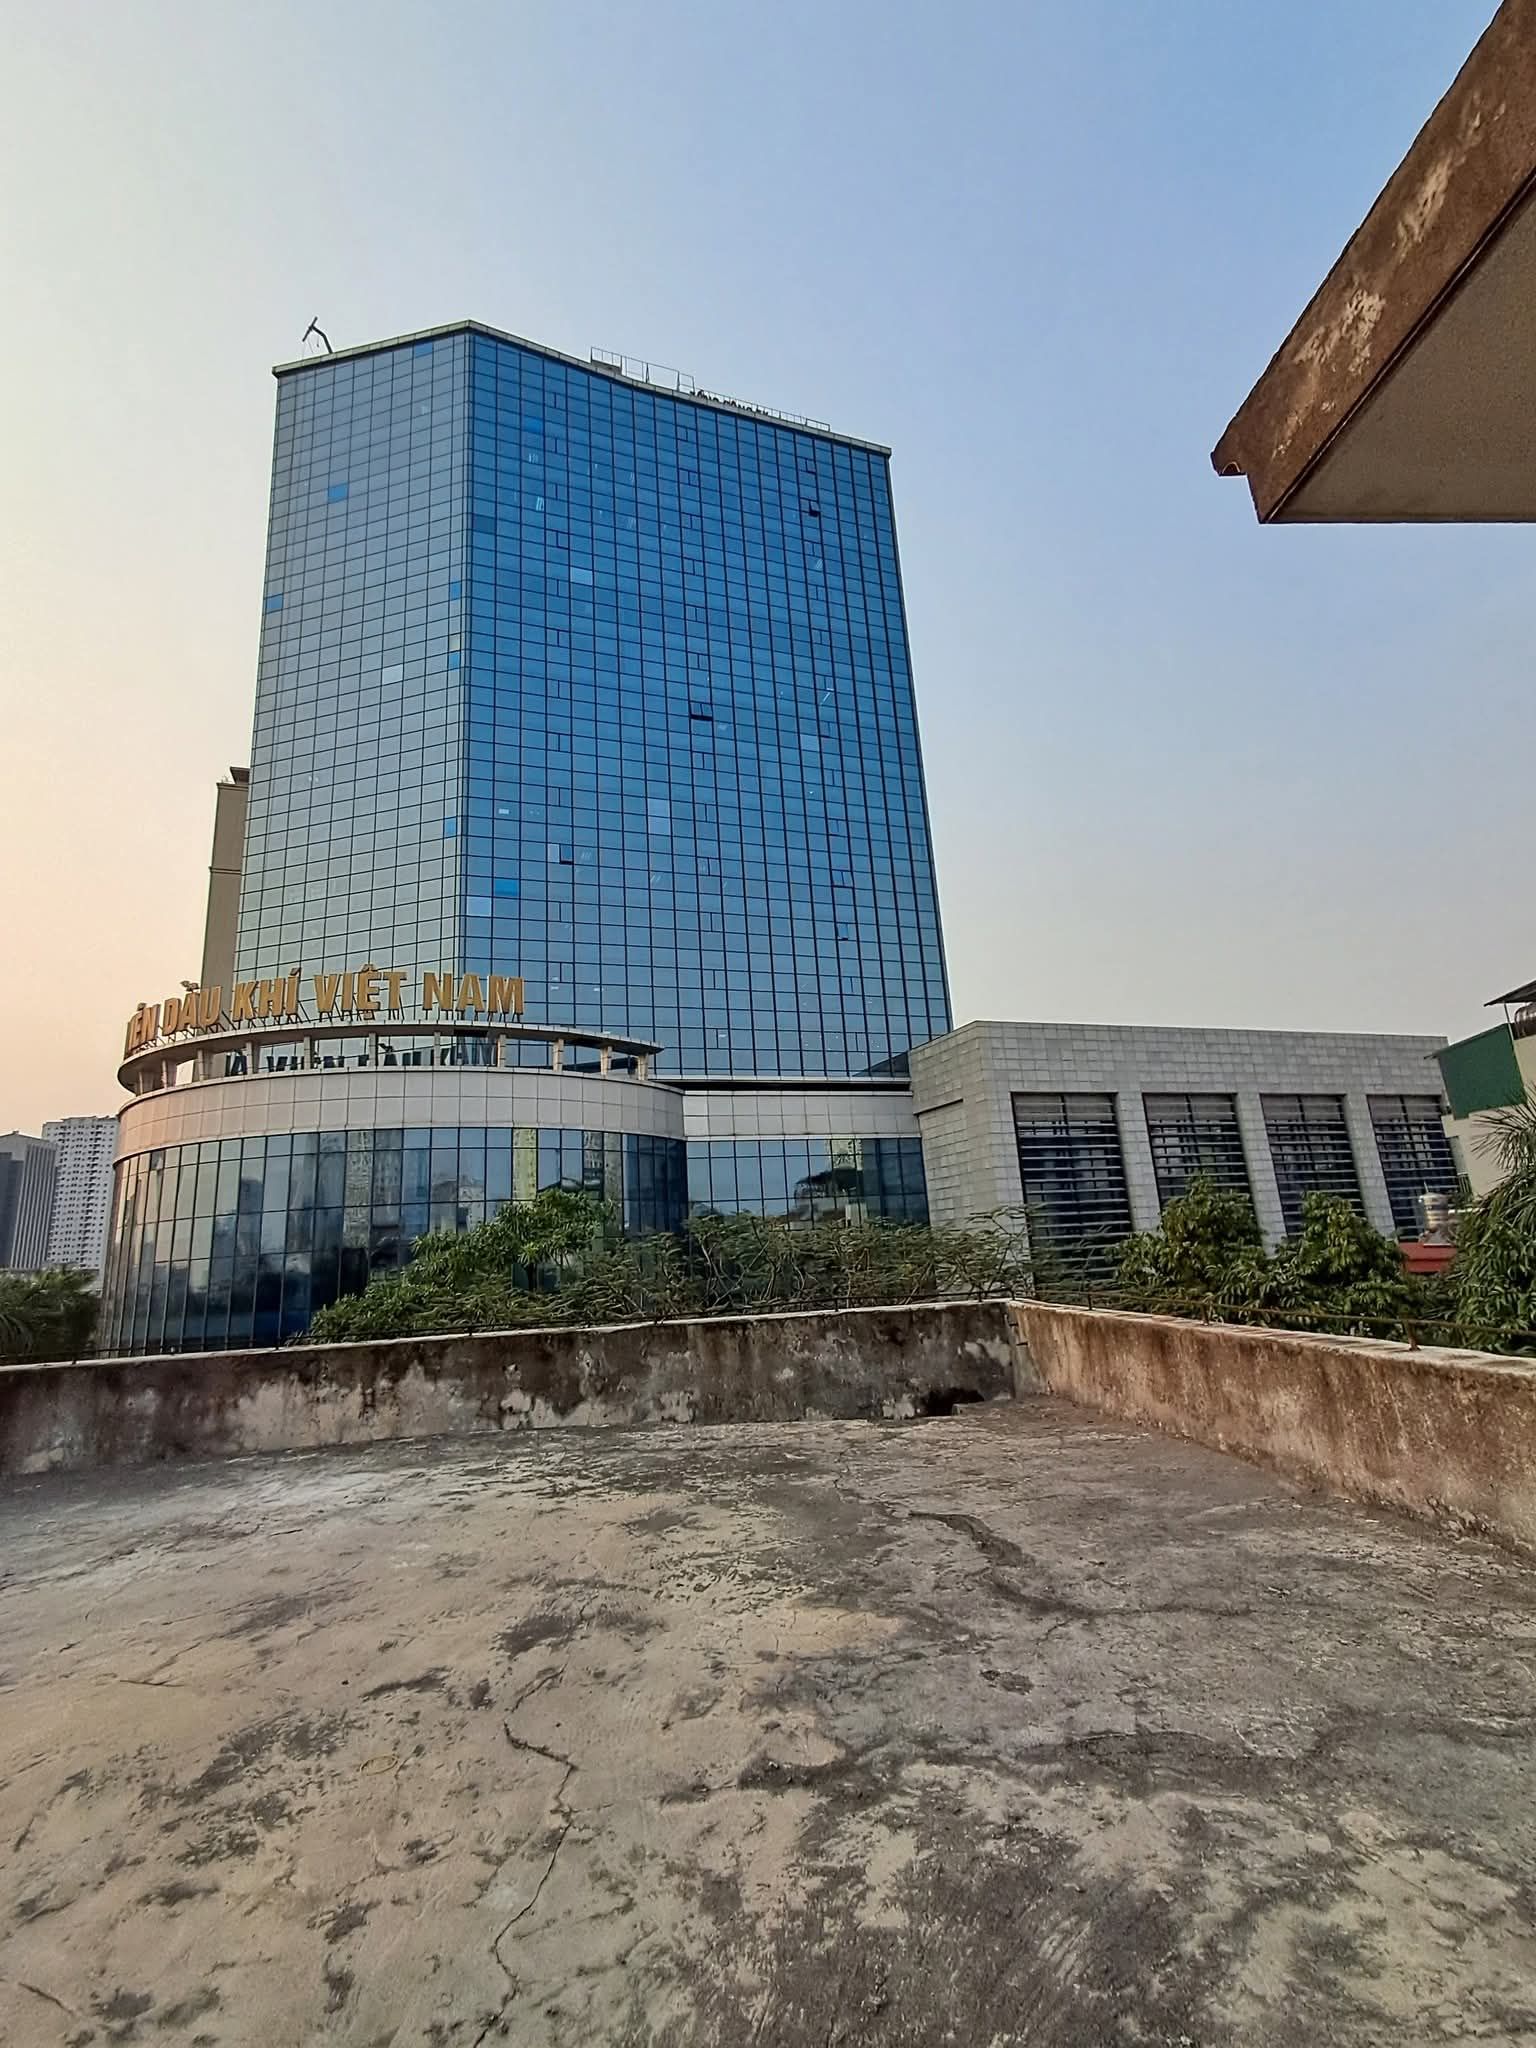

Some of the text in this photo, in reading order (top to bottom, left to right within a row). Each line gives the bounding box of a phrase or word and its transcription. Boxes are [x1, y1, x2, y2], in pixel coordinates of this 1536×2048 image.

[232, 967, 301, 1022] KHÍ
[313, 963, 407, 1020] VIỆT
[422, 971, 524, 1014] NAM
